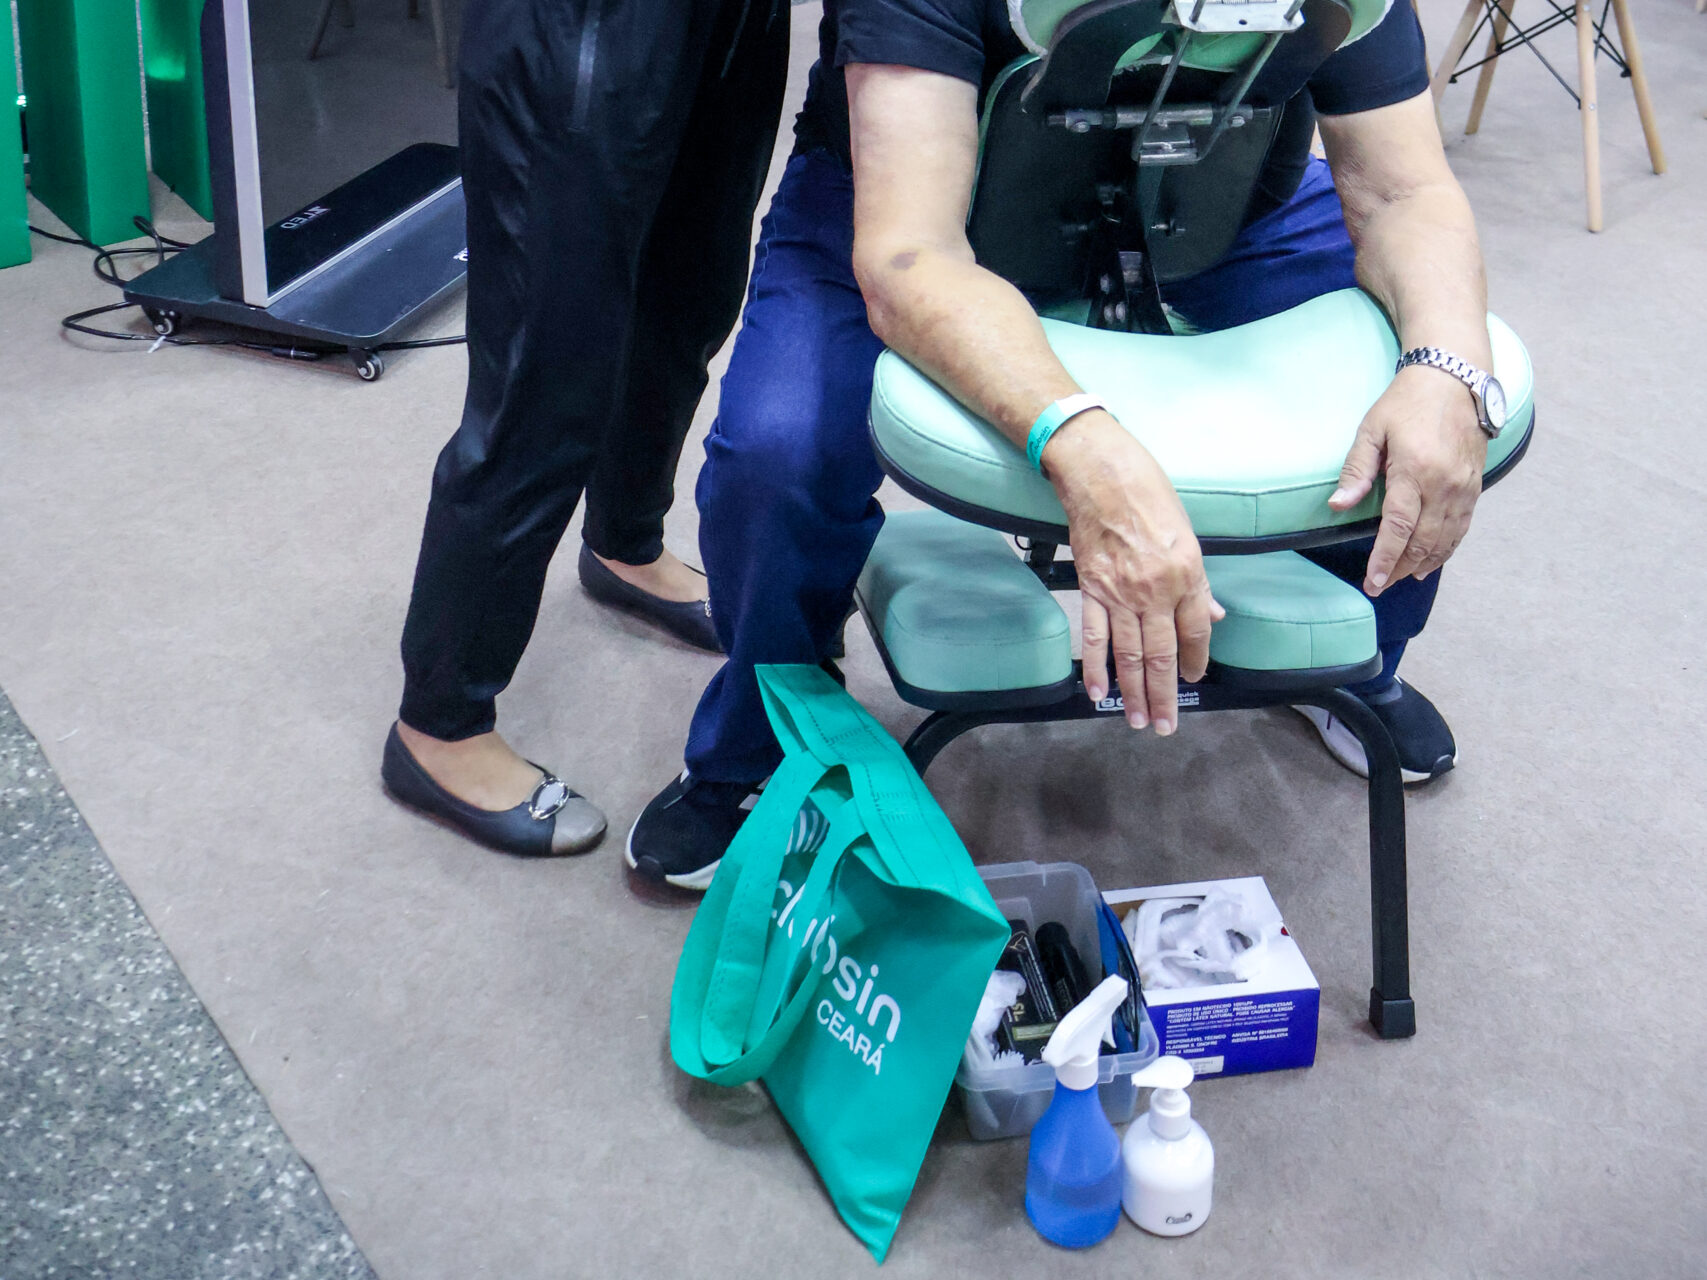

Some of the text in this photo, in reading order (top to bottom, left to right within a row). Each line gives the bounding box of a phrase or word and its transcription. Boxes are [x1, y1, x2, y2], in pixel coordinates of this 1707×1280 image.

[1167, 1007, 1192, 1015] PRODUTO
[1251, 1007, 1270, 1015] CAUSAR
[816, 999, 886, 1076] CEARÁ
